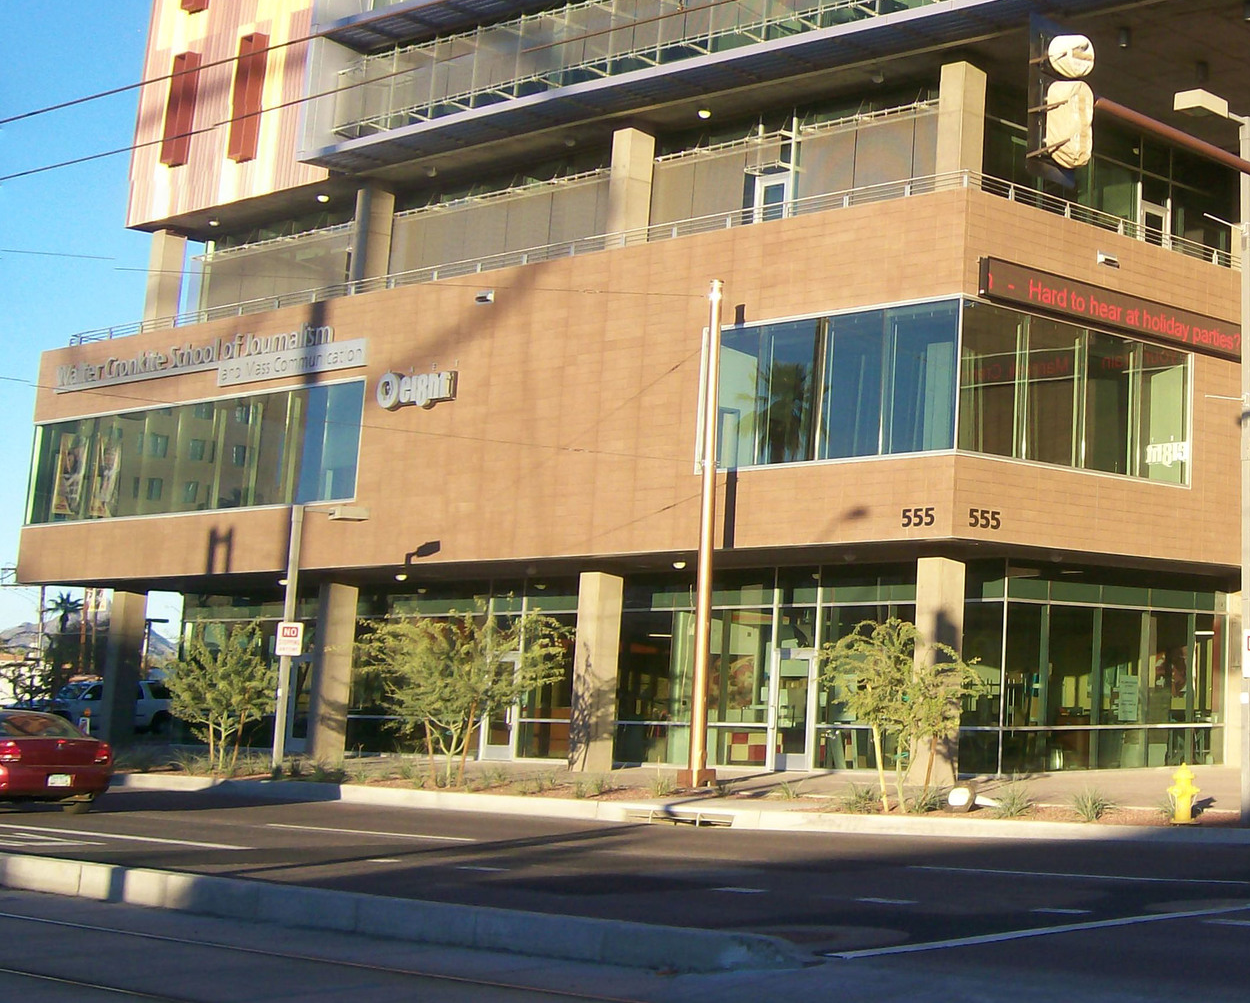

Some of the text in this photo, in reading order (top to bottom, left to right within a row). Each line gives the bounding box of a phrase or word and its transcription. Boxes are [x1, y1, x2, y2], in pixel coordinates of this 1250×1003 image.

[1028, 278, 1067, 309] Hard
[1071, 291, 1086, 313] to
[1089, 295, 1122, 322] hear
[1126, 308, 1140, 327] at
[1142, 309, 1190, 343] holiday
[1192, 326, 1241, 351] parties?
[58, 322, 334, 387] Walter Cronkite School of Journalism
[901, 507, 935, 528] 555
[968, 508, 1001, 530] 555
[284, 628, 297, 636] NO
